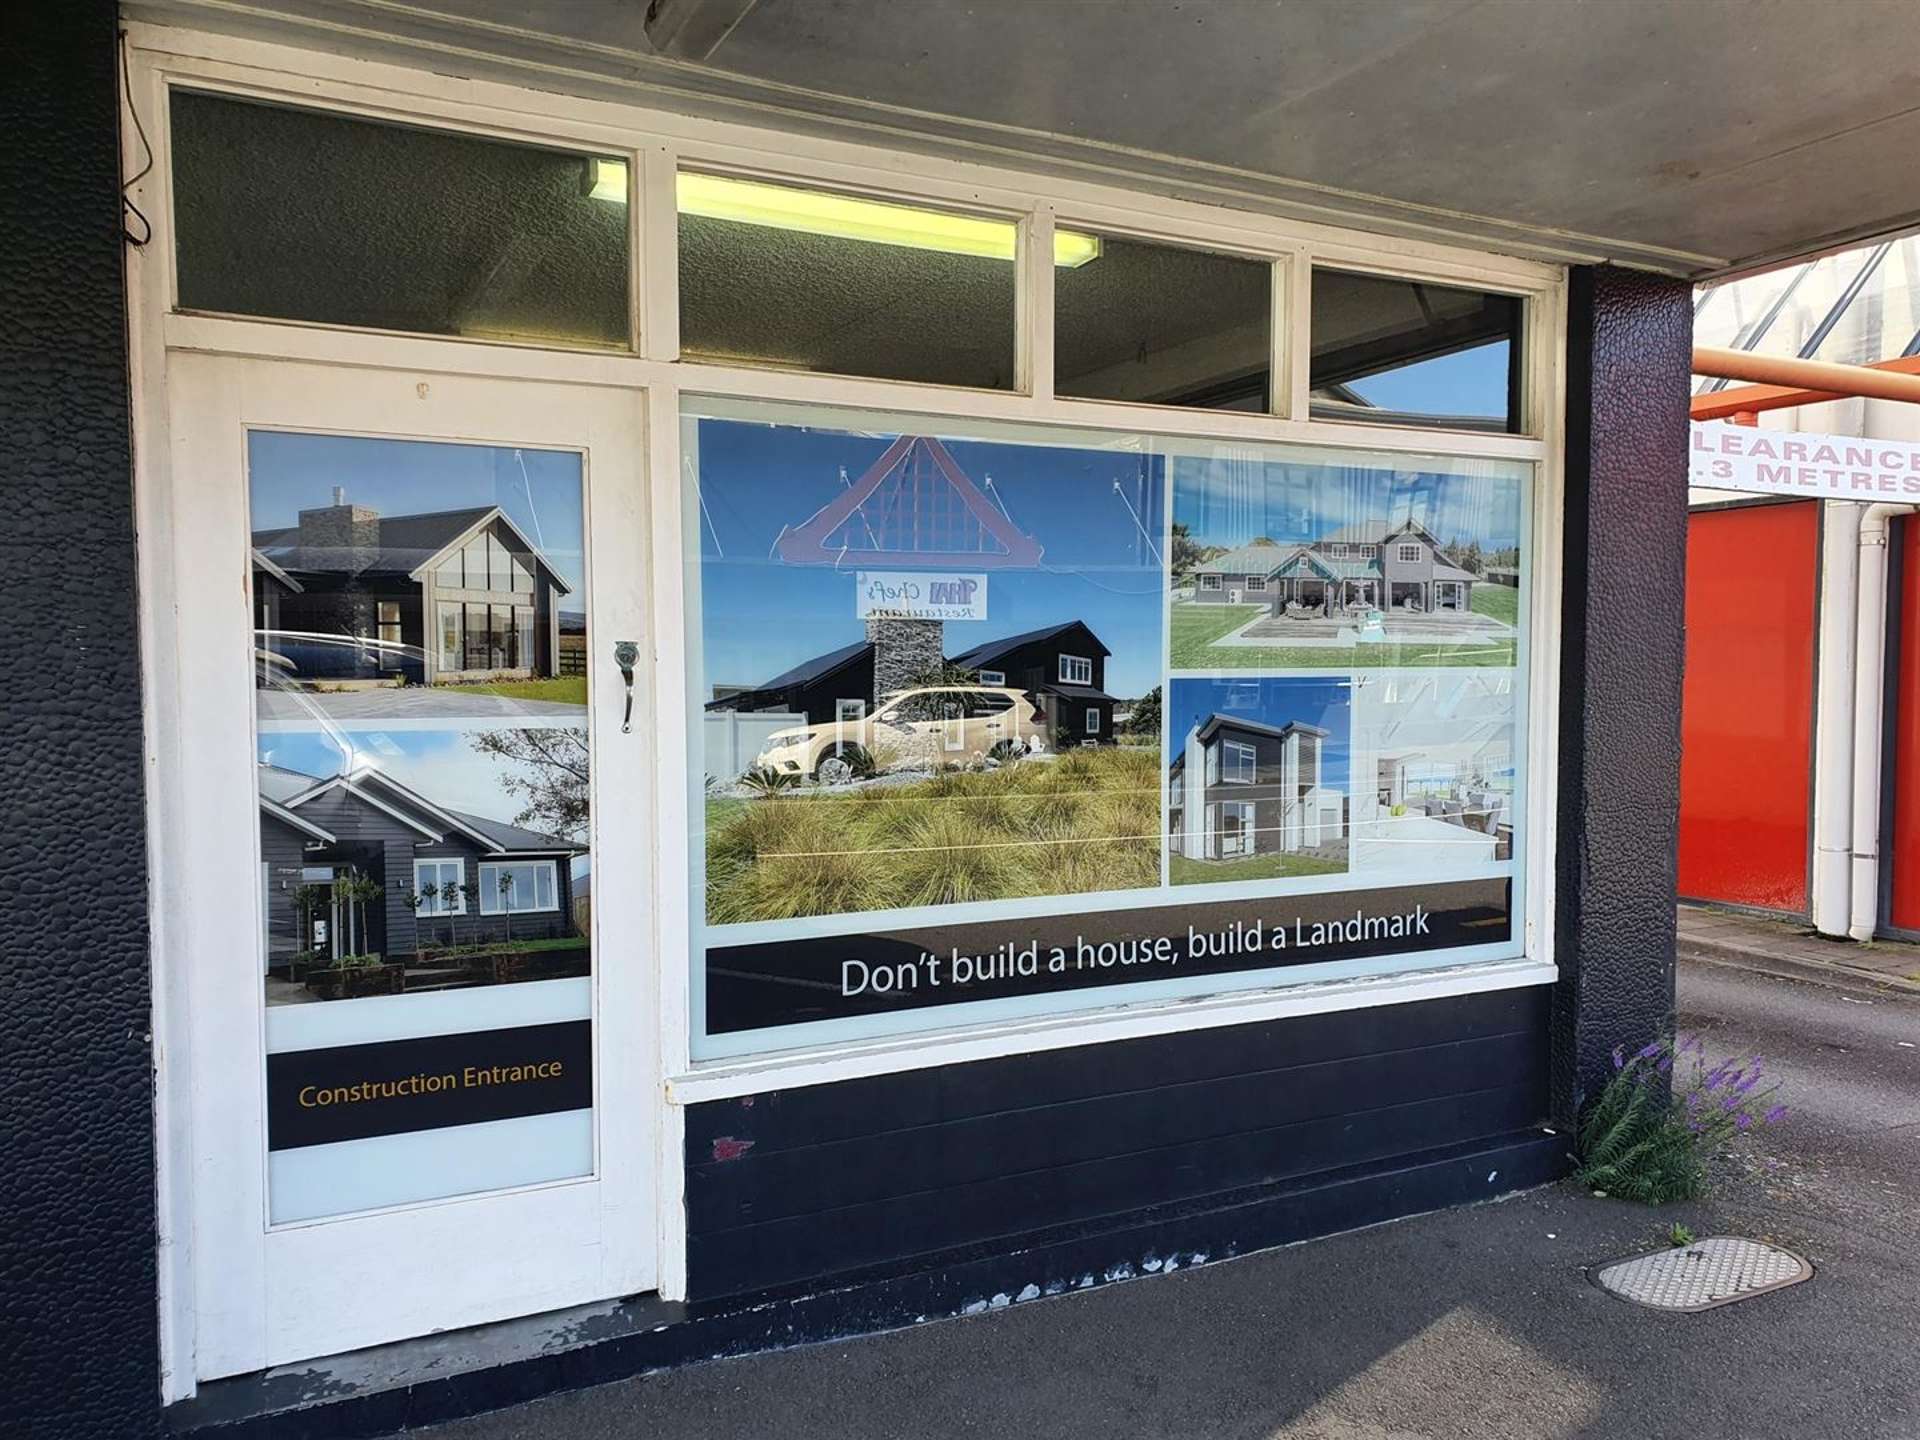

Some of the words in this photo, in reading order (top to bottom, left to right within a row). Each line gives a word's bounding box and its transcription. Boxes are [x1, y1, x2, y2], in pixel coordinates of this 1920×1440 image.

[1756, 464, 1920, 494] METRES
[840, 951, 941, 997] Don't
[951, 940, 1039, 984] build
[1048, 949, 1066, 973] a
[1077, 930, 1178, 970] house,
[1189, 919, 1263, 959] build
[1272, 928, 1287, 949] a
[1296, 905, 1431, 947] Landmark
[299, 1072, 457, 1108] Construction
[463, 1060, 563, 1088] Entrance
